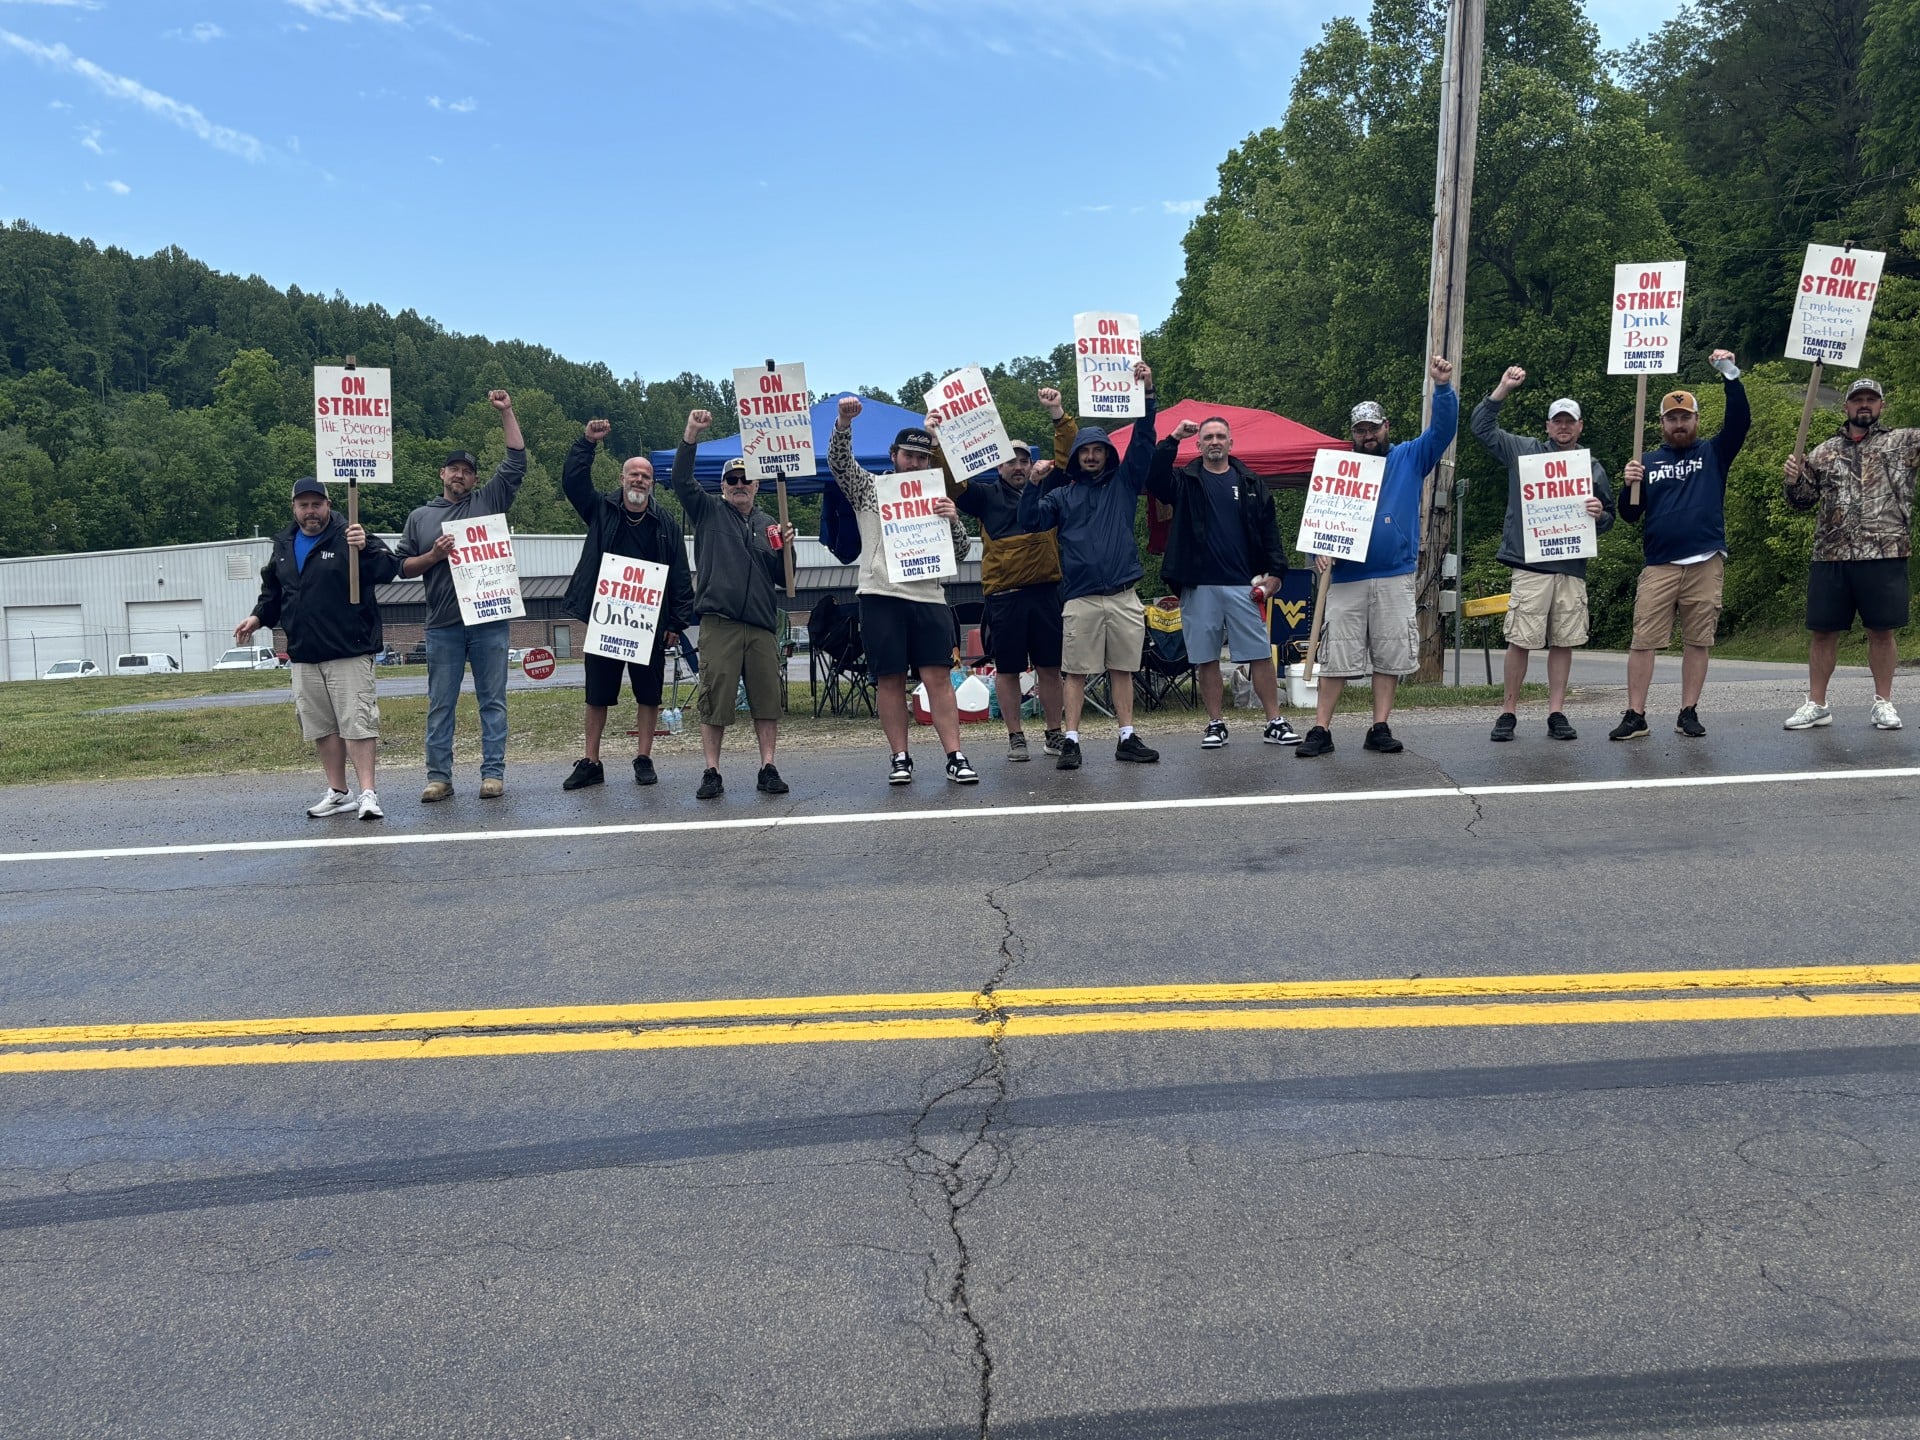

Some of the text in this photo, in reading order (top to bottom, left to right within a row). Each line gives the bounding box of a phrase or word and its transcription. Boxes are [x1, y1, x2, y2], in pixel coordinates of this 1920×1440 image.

[1830, 257, 1856, 277] ON
[1639, 272, 1662, 290] ON
[1802, 274, 1876, 301] STRIKE!
[1616, 290, 1682, 310] STRIKE!
[1623, 312, 1670, 328] Drink
[1803, 312, 1853, 326] Deserve
[1098, 319, 1119, 336] ON
[1078, 338, 1140, 356] STRIKE!
[1803, 336, 1847, 350] TEAMSTERS
[1624, 351, 1664, 360] TEAMSTERS
[1802, 346, 1843, 360] LOCAL 175
[1082, 356, 1134, 372] Drink
[1650, 360, 1662, 368] 175
[342, 376, 365, 395] ON
[760, 374, 783, 394] ON
[943, 379, 965, 399] ON
[740, 392, 807, 416] STRIKE!
[1091, 394, 1130, 403] TEAMSTERS
[318, 397, 390, 416] STRIKE!
[1093, 404, 1114, 412] LOCAL
[318, 418, 338, 432] THE
[741, 418, 772, 430] Bad
[939, 420, 961, 435] Bad
[743, 428, 769, 455] Drink
[758, 454, 800, 464] TEAMSTERS
[961, 444, 998, 464] TEAMSTERS
[333, 458, 376, 467] TEAMSTERS
[761, 464, 800, 473] LOCAL 175
[966, 452, 1000, 472] LOCAL 175
[1338, 460, 1361, 478] ON
[1544, 460, 1567, 478] ON
[334, 468, 376, 477] LOCAL 175
[900, 480, 922, 498] ON
[1312, 476, 1378, 501] STRIKE!
[1523, 478, 1590, 501] STRIKE!
[881, 497, 940, 521] STRIKE
[1526, 503, 1580, 515] Beverage
[1304, 518, 1320, 528] Not
[466, 525, 488, 544] ON
[1314, 532, 1354, 546] TEAMSTERS
[1539, 536, 1581, 547] TEAMSTERS
[448, 540, 512, 566] STRIKE!
[1313, 541, 1350, 554] LOCAL 175
[1541, 546, 1580, 556] LOCAL 175
[900, 555, 940, 568] TEAMSTERS
[452, 566, 476, 581] THE
[622, 566, 645, 584] ON
[903, 565, 940, 576] LOCAL 175
[476, 588, 518, 600] UNFAIR
[598, 579, 662, 606] STRIKE!
[474, 597, 511, 610] TEAMSTERS
[477, 606, 512, 618] LOCAL 175
[600, 634, 639, 649] TEAMSTERS
[537, 652, 549, 660] NOT
[600, 644, 636, 658] LOCAL 175
[532, 666, 550, 676] ENTER
